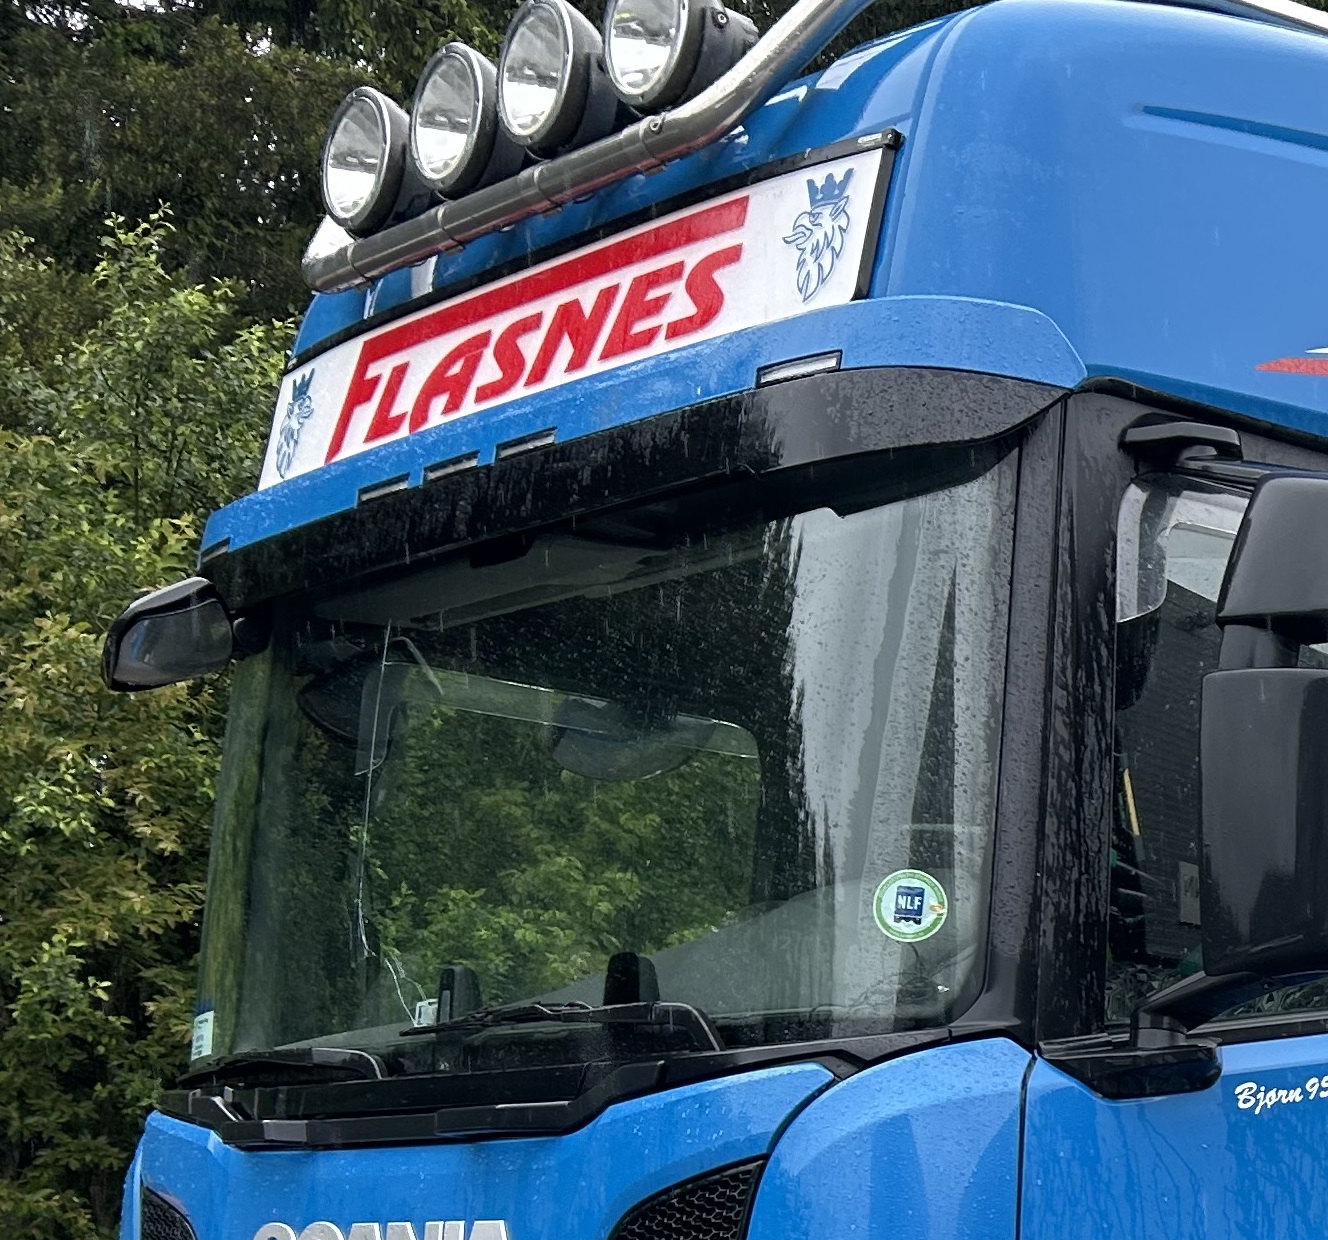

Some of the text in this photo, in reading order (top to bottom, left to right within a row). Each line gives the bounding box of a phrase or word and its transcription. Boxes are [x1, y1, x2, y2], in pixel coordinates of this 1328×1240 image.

[325, 194, 750, 466] FLASNES
[896, 894, 923, 911] NLF
[1234, 1081, 1304, 1115] Bjørn
